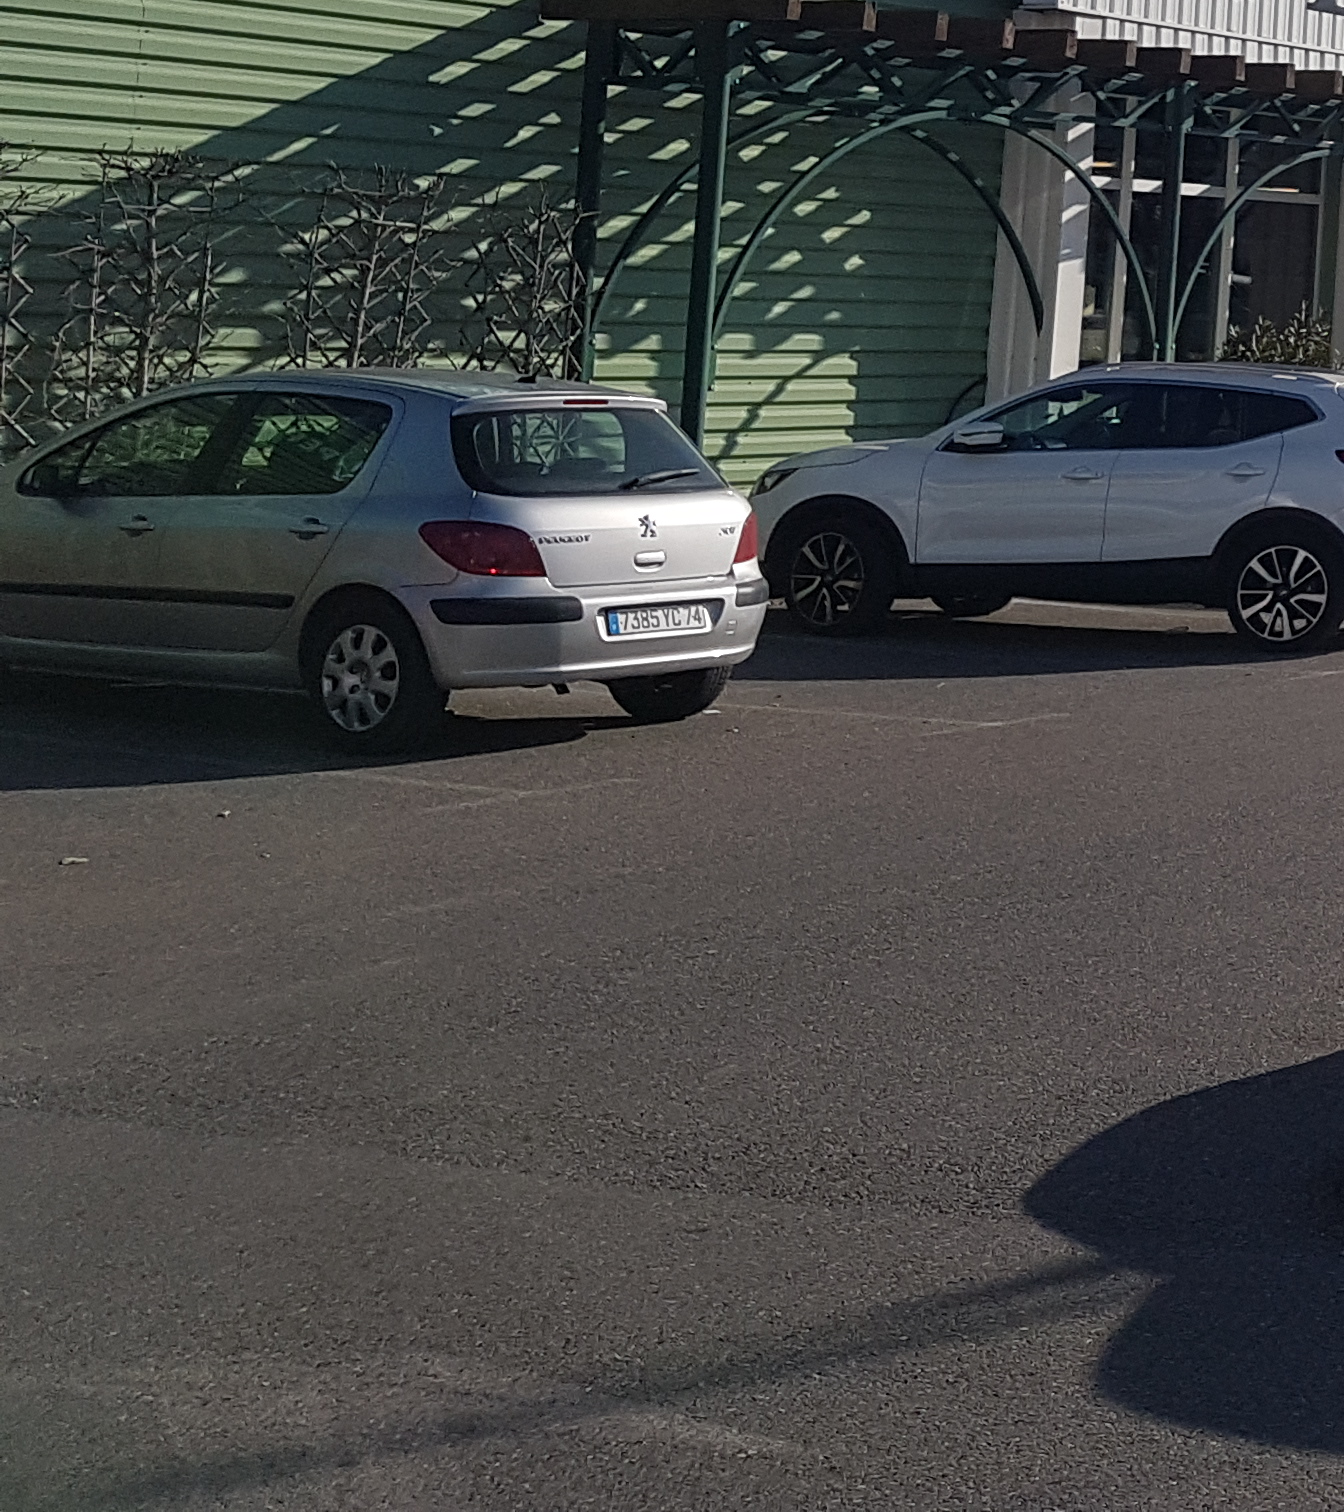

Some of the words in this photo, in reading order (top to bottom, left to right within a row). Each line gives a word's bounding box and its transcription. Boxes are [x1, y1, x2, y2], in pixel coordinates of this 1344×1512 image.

[621, 609, 660, 631] 7385
[662, 608, 682, 627] YC
[685, 605, 702, 625] 74
